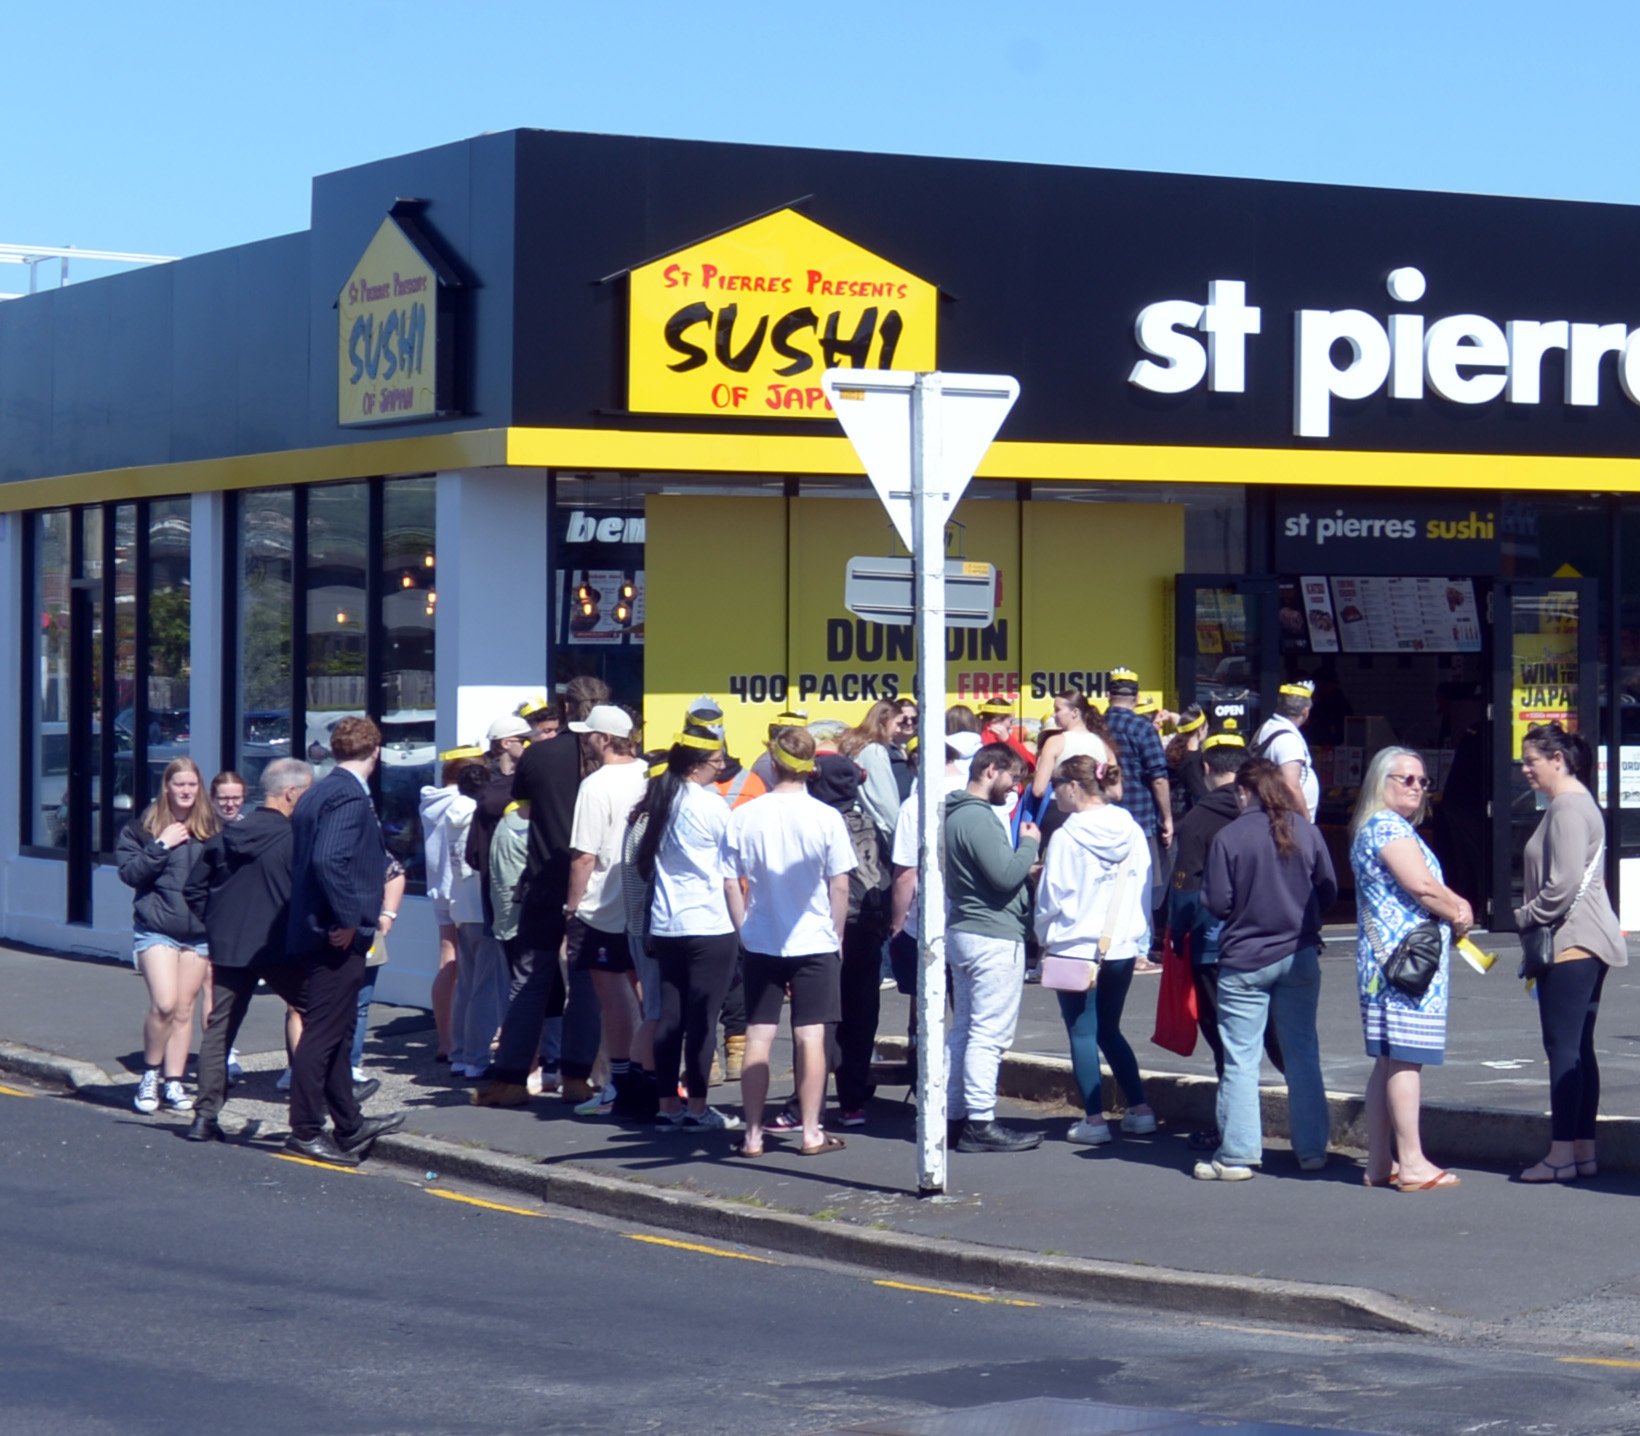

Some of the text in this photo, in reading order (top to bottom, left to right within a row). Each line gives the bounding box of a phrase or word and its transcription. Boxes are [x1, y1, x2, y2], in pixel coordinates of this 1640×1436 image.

[663, 264, 908, 299] St Pierres Presents
[349, 302, 425, 384] SUSHI
[663, 301, 904, 377] SUSHI
[1129, 280, 1261, 394] st
[711, 383, 832, 410] OF JAP
[566, 511, 645, 542] ben
[1285, 514, 1311, 536] st
[1317, 510, 1417, 545] pierres
[1427, 512, 1494, 540] sushi
[827, 618, 1008, 662] DUNDIN
[730, 674, 787, 703] 400
[800, 674, 899, 701] PACKS
[958, 673, 1019, 699] FREE
[1521, 663, 1558, 684] WIN
[1215, 705, 1244, 717] OPEN
